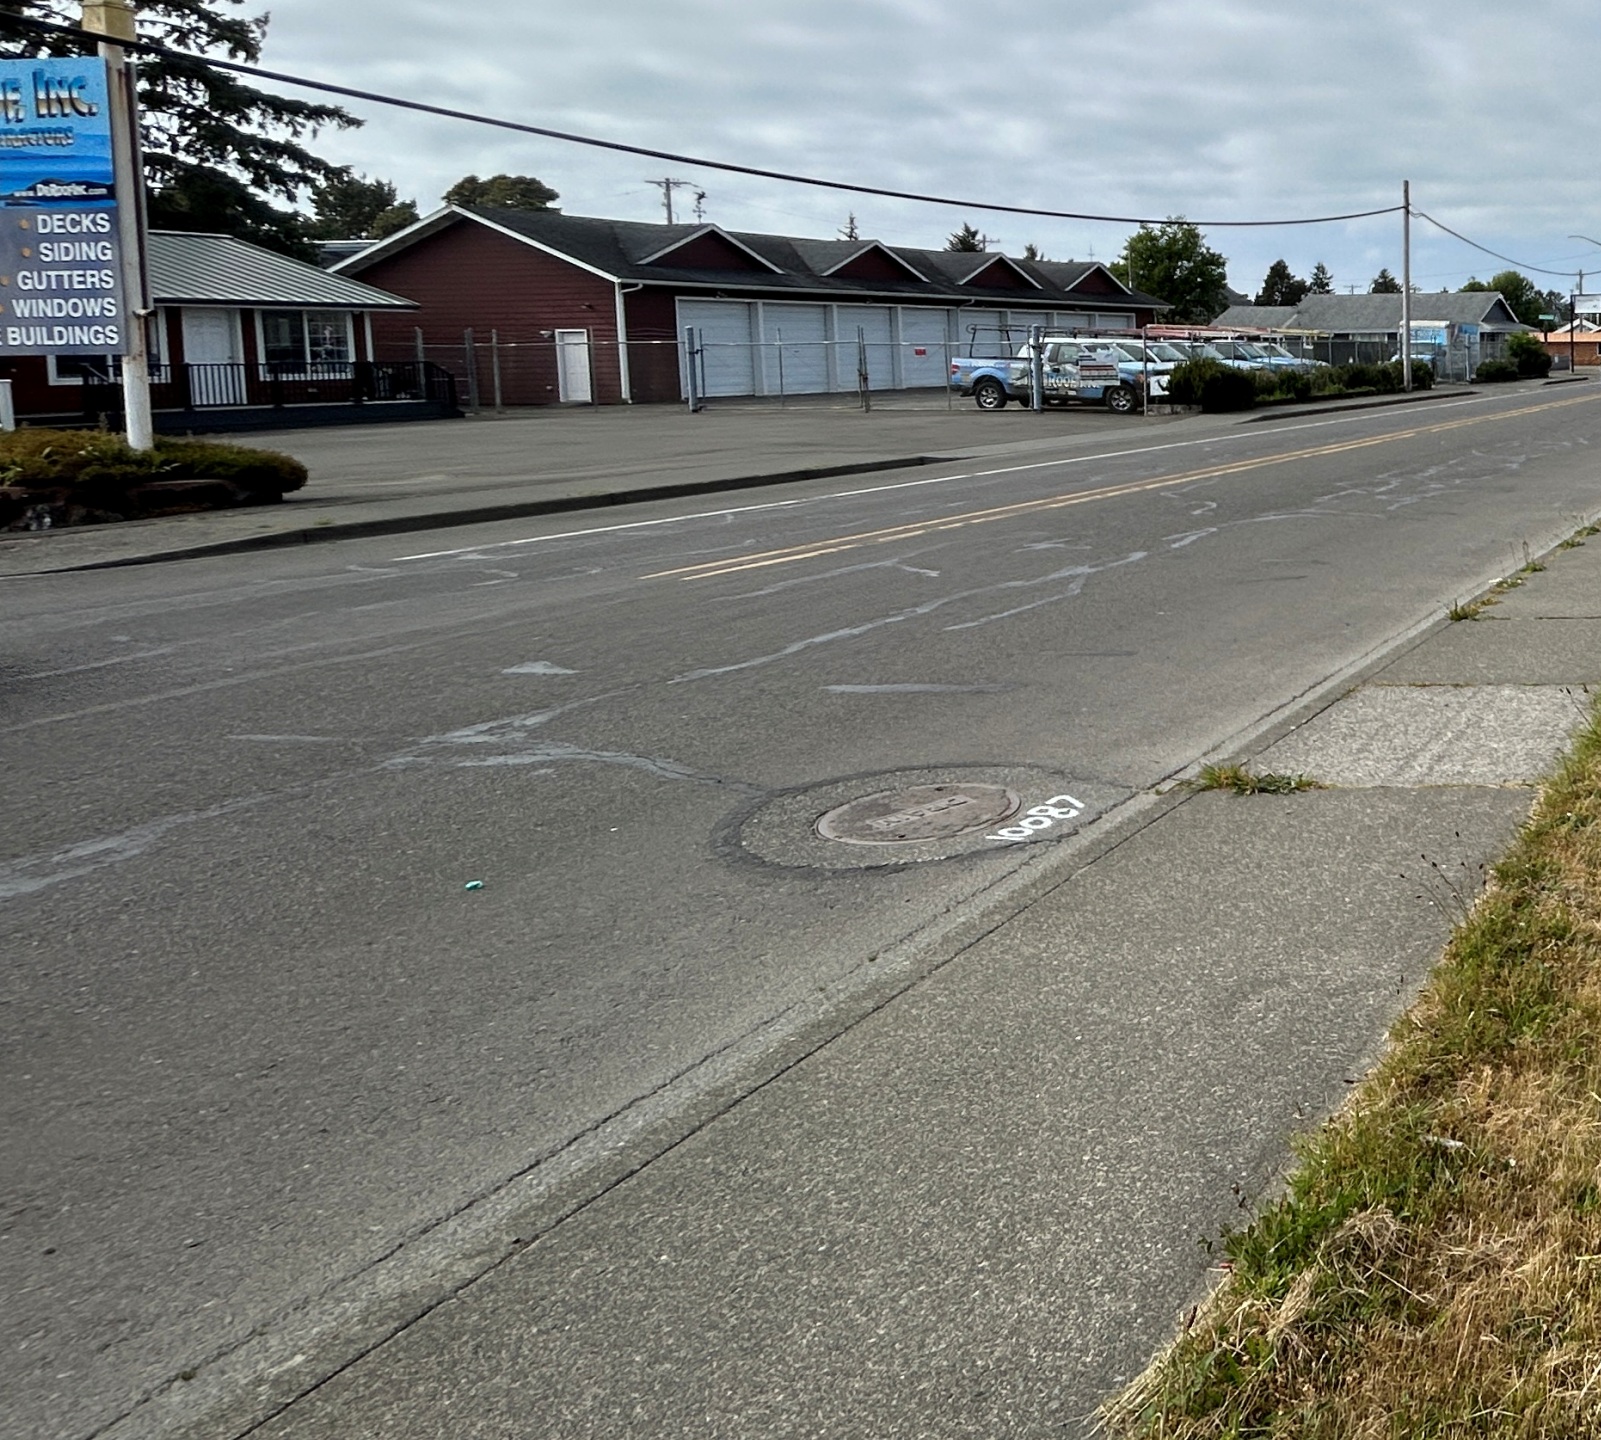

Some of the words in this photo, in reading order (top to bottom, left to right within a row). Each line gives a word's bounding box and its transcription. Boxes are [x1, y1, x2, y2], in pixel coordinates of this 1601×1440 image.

[37, 213, 111, 233] DECKS
[39, 241, 112, 262] SIDING
[17, 269, 115, 290] GUTTERS
[12, 298, 117, 318] WINDOWS
[6, 325, 119, 346] BUILDINGS
